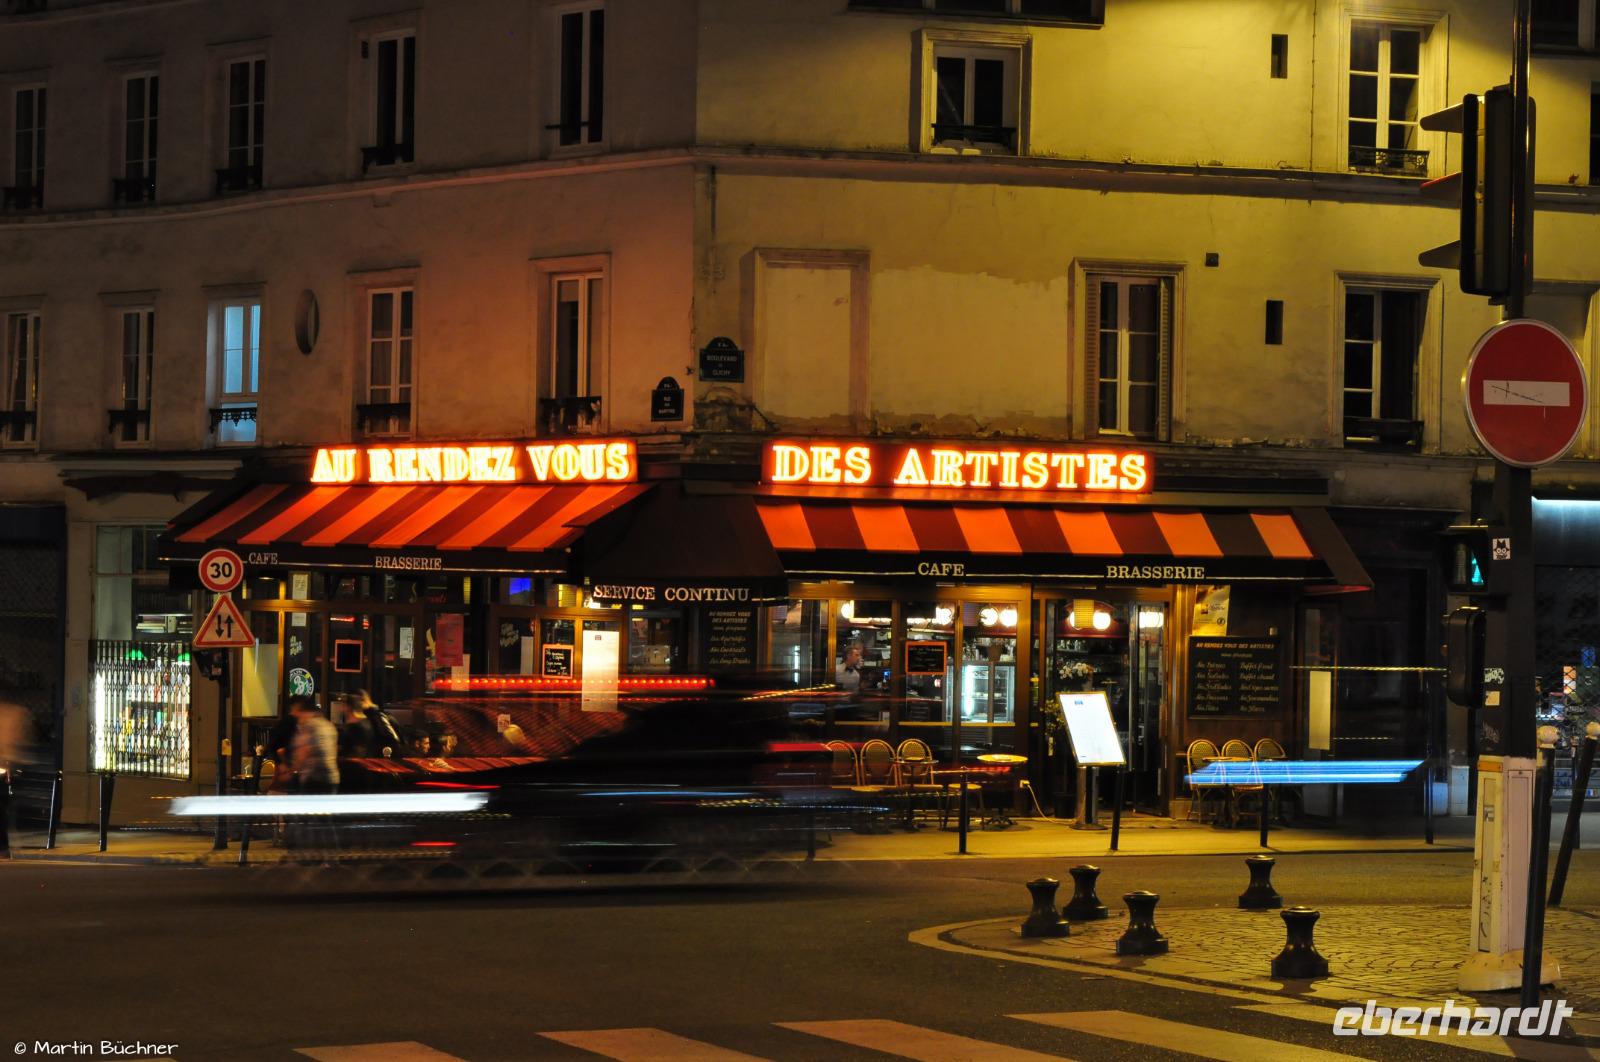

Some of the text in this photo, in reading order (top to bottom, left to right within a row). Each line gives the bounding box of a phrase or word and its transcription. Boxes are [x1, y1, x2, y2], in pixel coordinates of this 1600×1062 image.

[310, 442, 630, 483] AU RENDEZ VOUS
[771, 444, 1147, 491] DES ARTISTES
[248, 552, 278, 565] CAFE
[375, 555, 442, 571] BRASSERIE
[209, 562, 233, 579] 30
[917, 562, 965, 577] CAFE
[1106, 565, 1205, 580] BRASSERIE
[593, 584, 749, 602] SERVICE CONTINU
